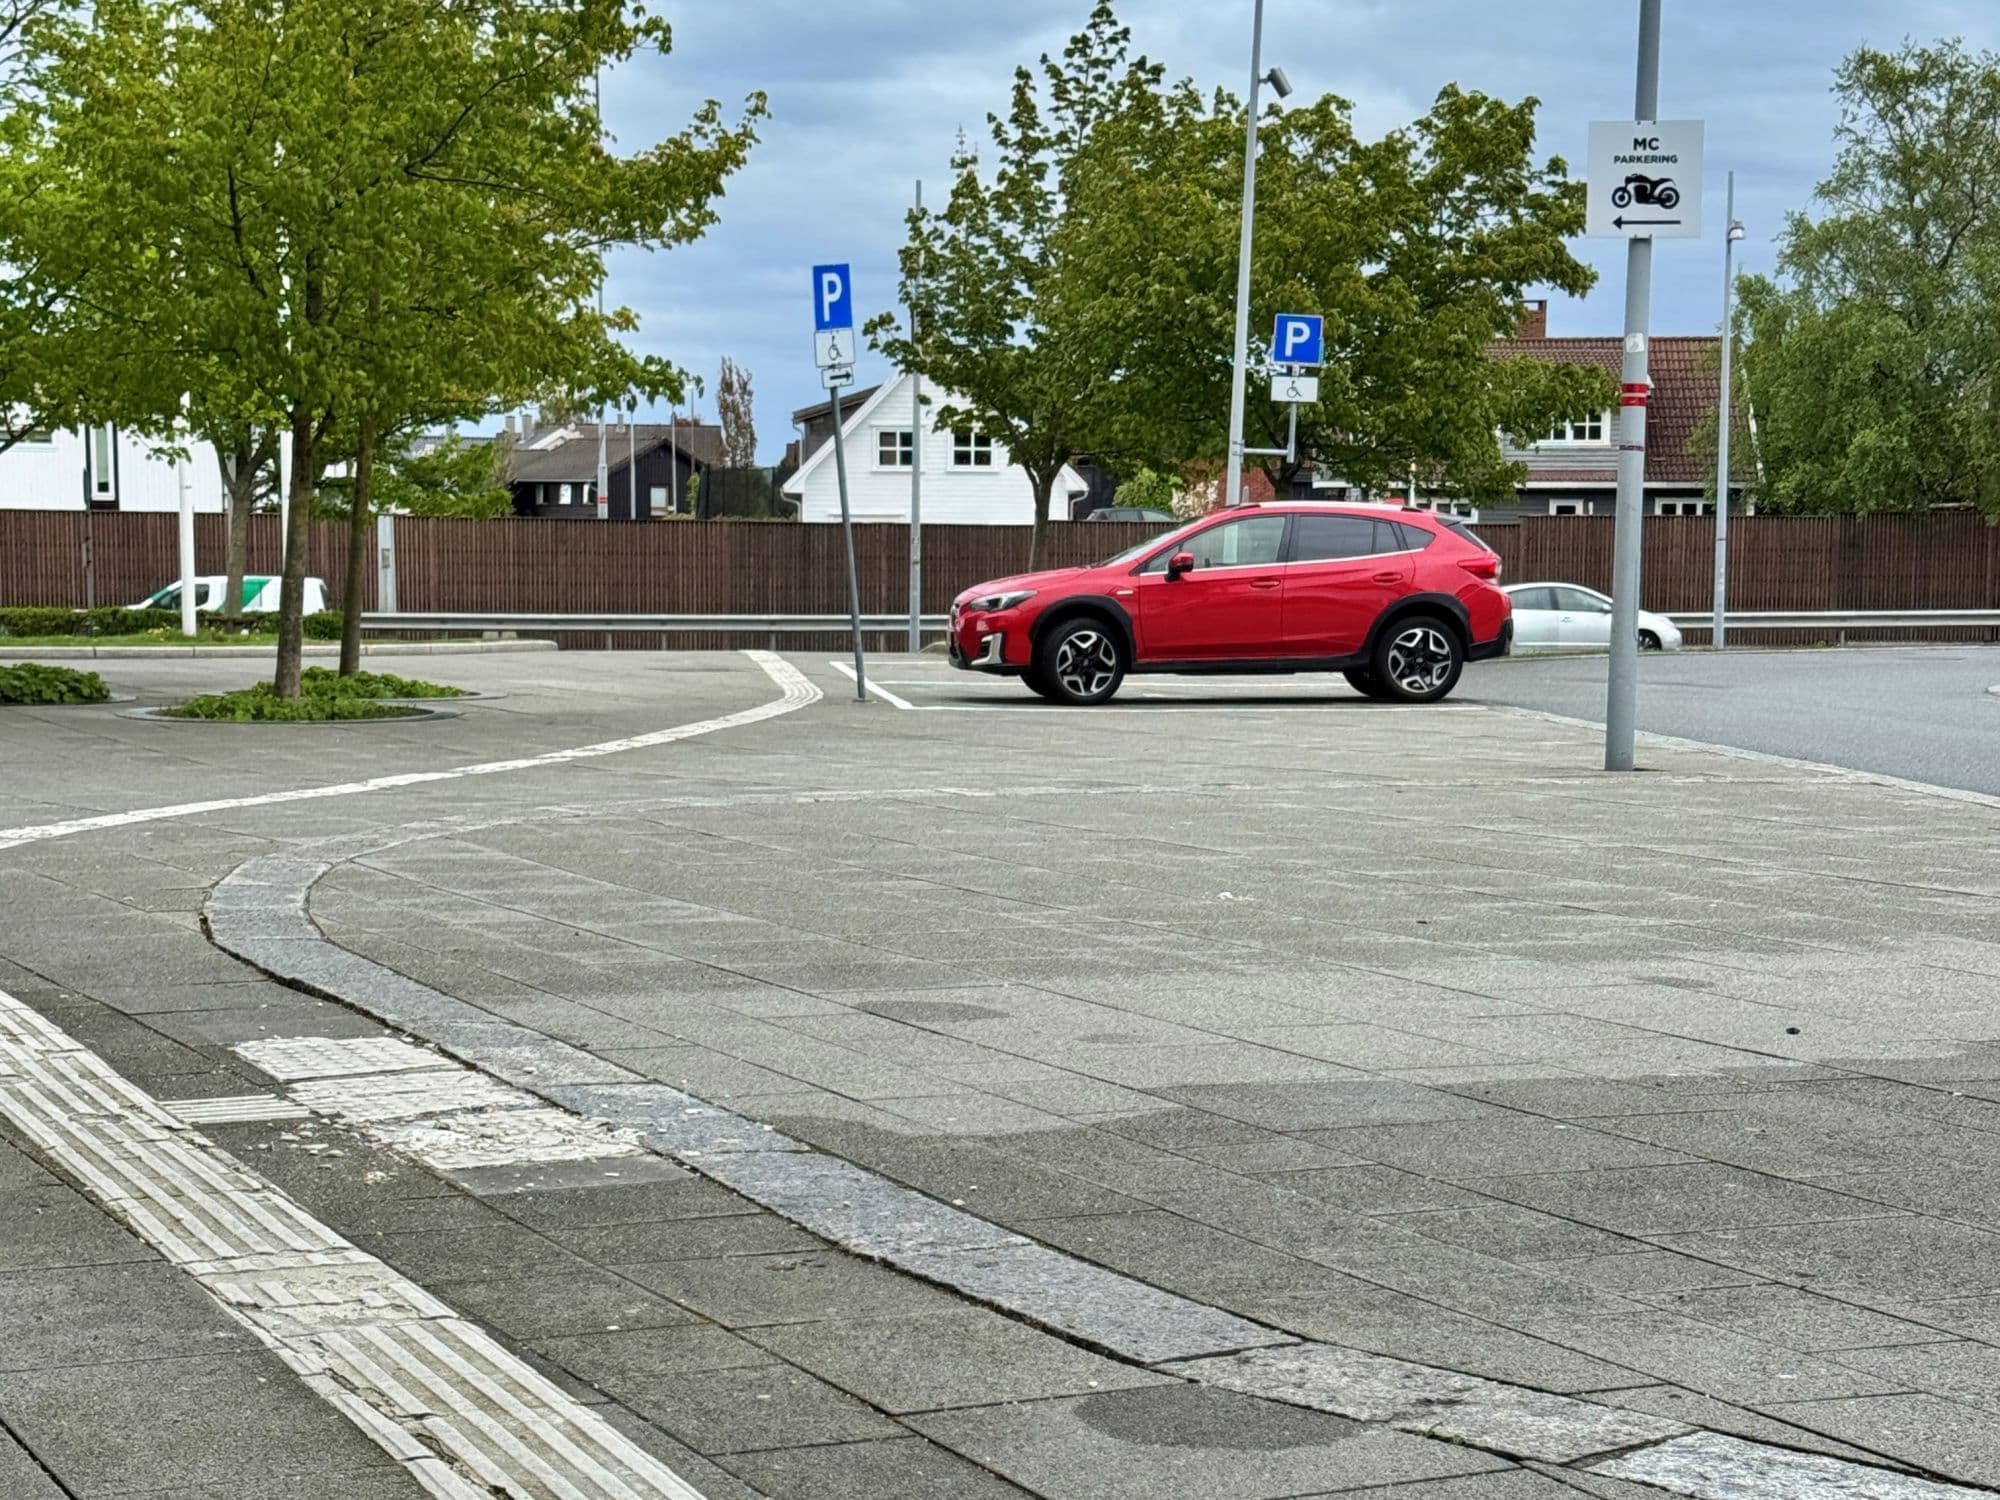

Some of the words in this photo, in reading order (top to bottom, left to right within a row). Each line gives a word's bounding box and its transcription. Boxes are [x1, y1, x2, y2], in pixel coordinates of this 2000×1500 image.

[1633, 138, 1660, 151] MC
[1614, 155, 1678, 164] PARKERING
[822, 272, 842, 322] P
[1285, 321, 1310, 357] P
